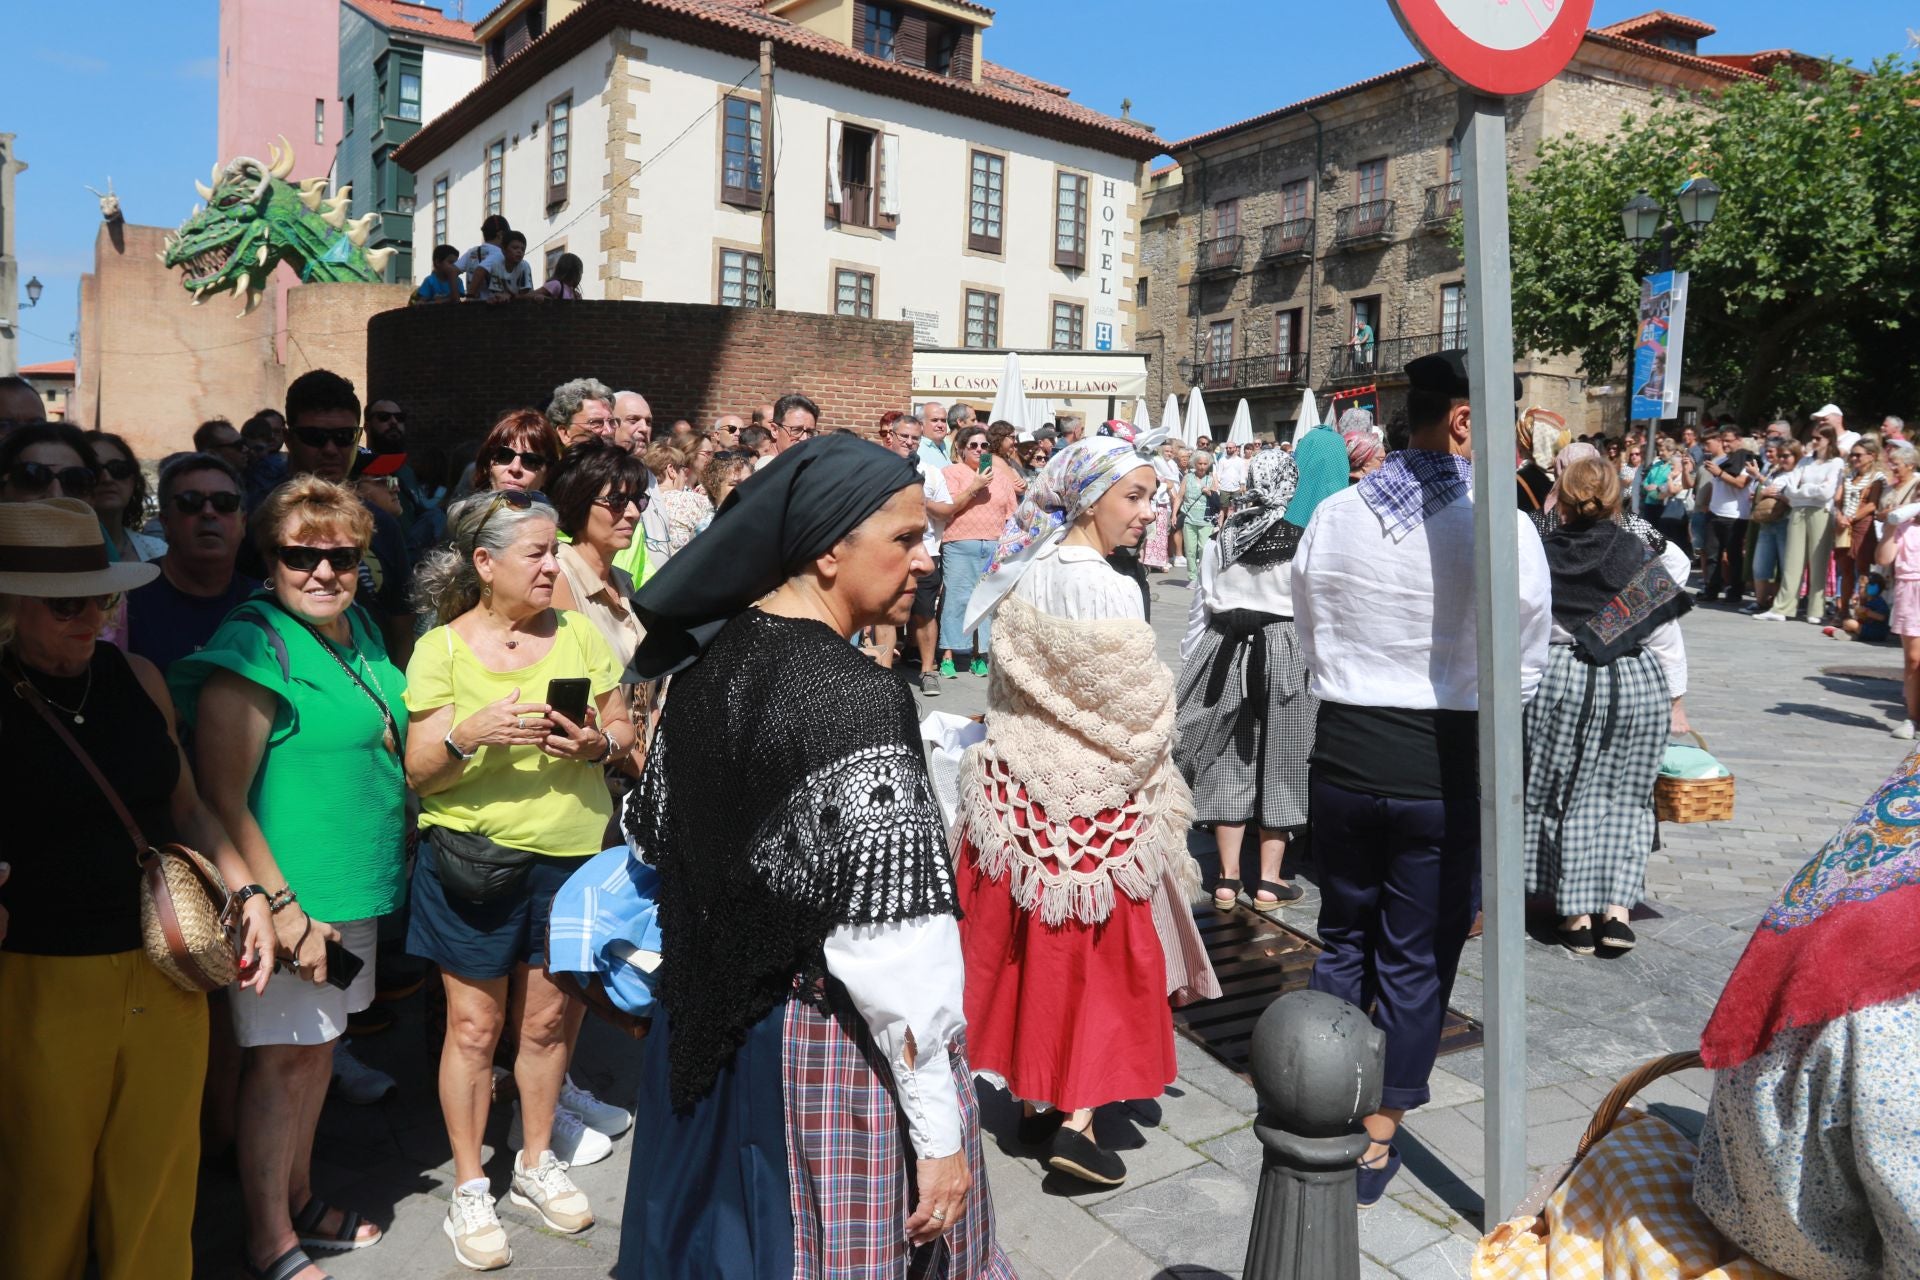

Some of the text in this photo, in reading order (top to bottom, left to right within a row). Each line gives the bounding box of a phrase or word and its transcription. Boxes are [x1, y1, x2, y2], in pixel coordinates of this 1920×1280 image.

[1101, 180, 1115, 294] HOTEL
[1097, 323, 1111, 342] H
[932, 375, 950, 388] LA
[954, 375, 998, 389] CASON
[1031, 377, 1118, 393] JOVELLANOS
